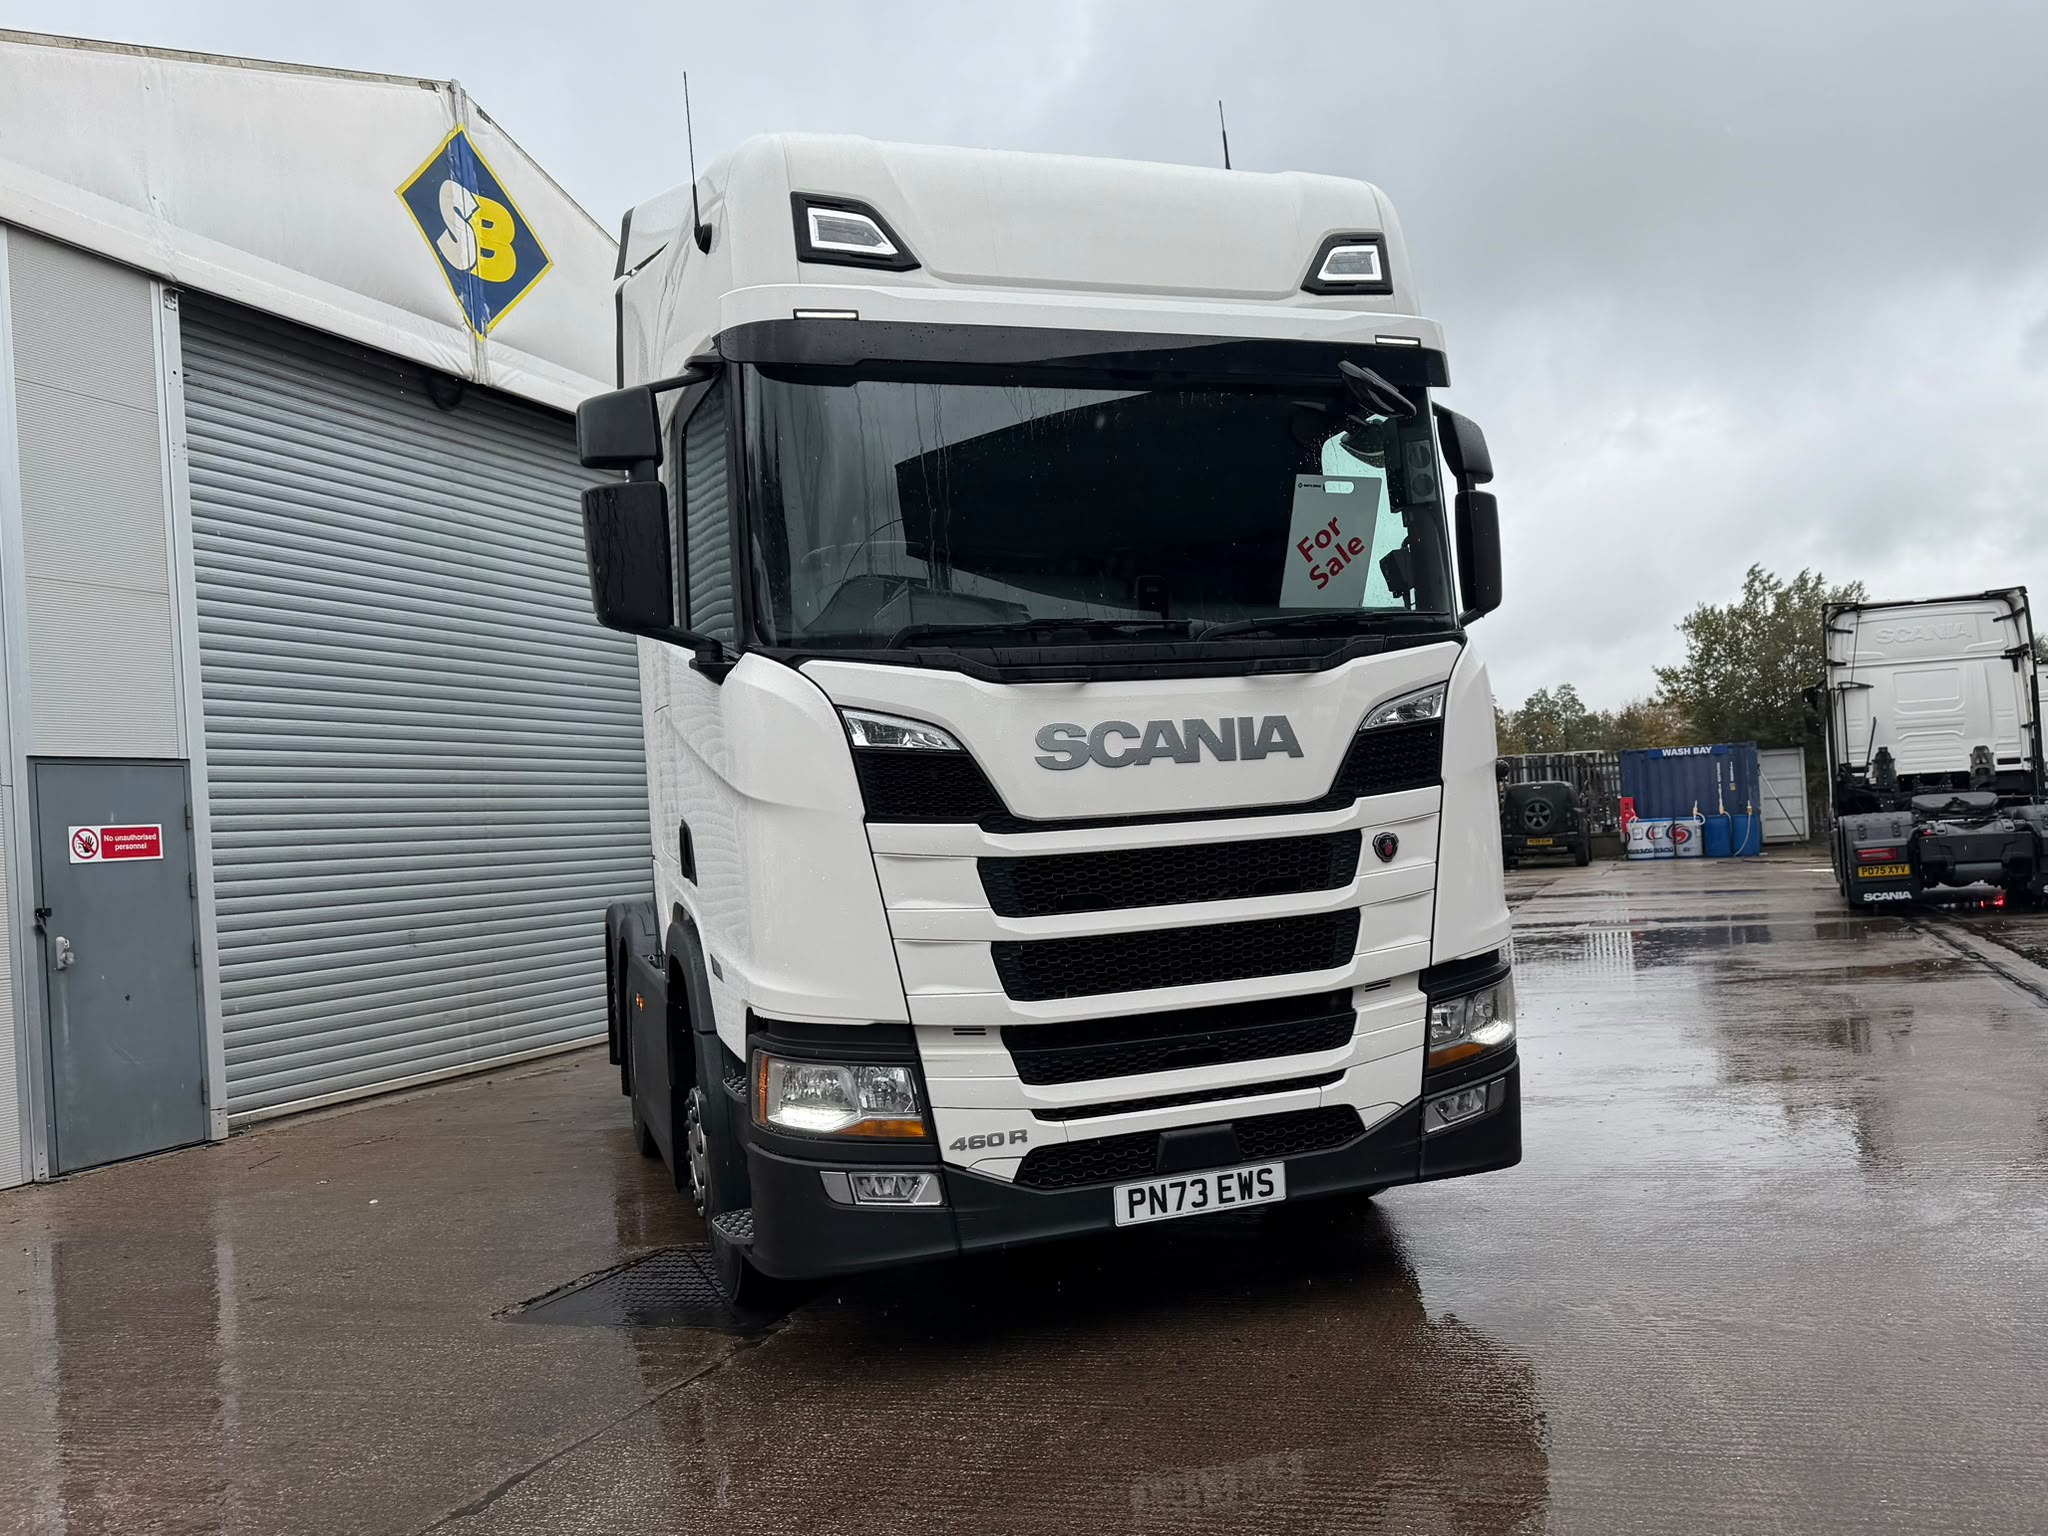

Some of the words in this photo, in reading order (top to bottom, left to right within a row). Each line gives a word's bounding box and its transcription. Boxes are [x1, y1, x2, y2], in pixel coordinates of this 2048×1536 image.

[436, 179, 517, 283] SB
[1297, 516, 1341, 563] For
[1309, 536, 1365, 590] Sale
[1875, 623, 1973, 645] SCANIA
[1034, 715, 1304, 770] SCANIA
[1662, 748, 1690, 756] WASH
[1693, 746, 1712, 754] BAY
[104, 834, 113, 842] No
[114, 833, 157, 842] unauthorised
[114, 842, 147, 852] personnel
[1864, 891, 1912, 902] SCANIA
[949, 1132, 1005, 1151] 460
[1009, 1129, 1028, 1145] R
[1128, 1178, 1208, 1219] PN73
[1217, 1168, 1274, 1203] EWS
